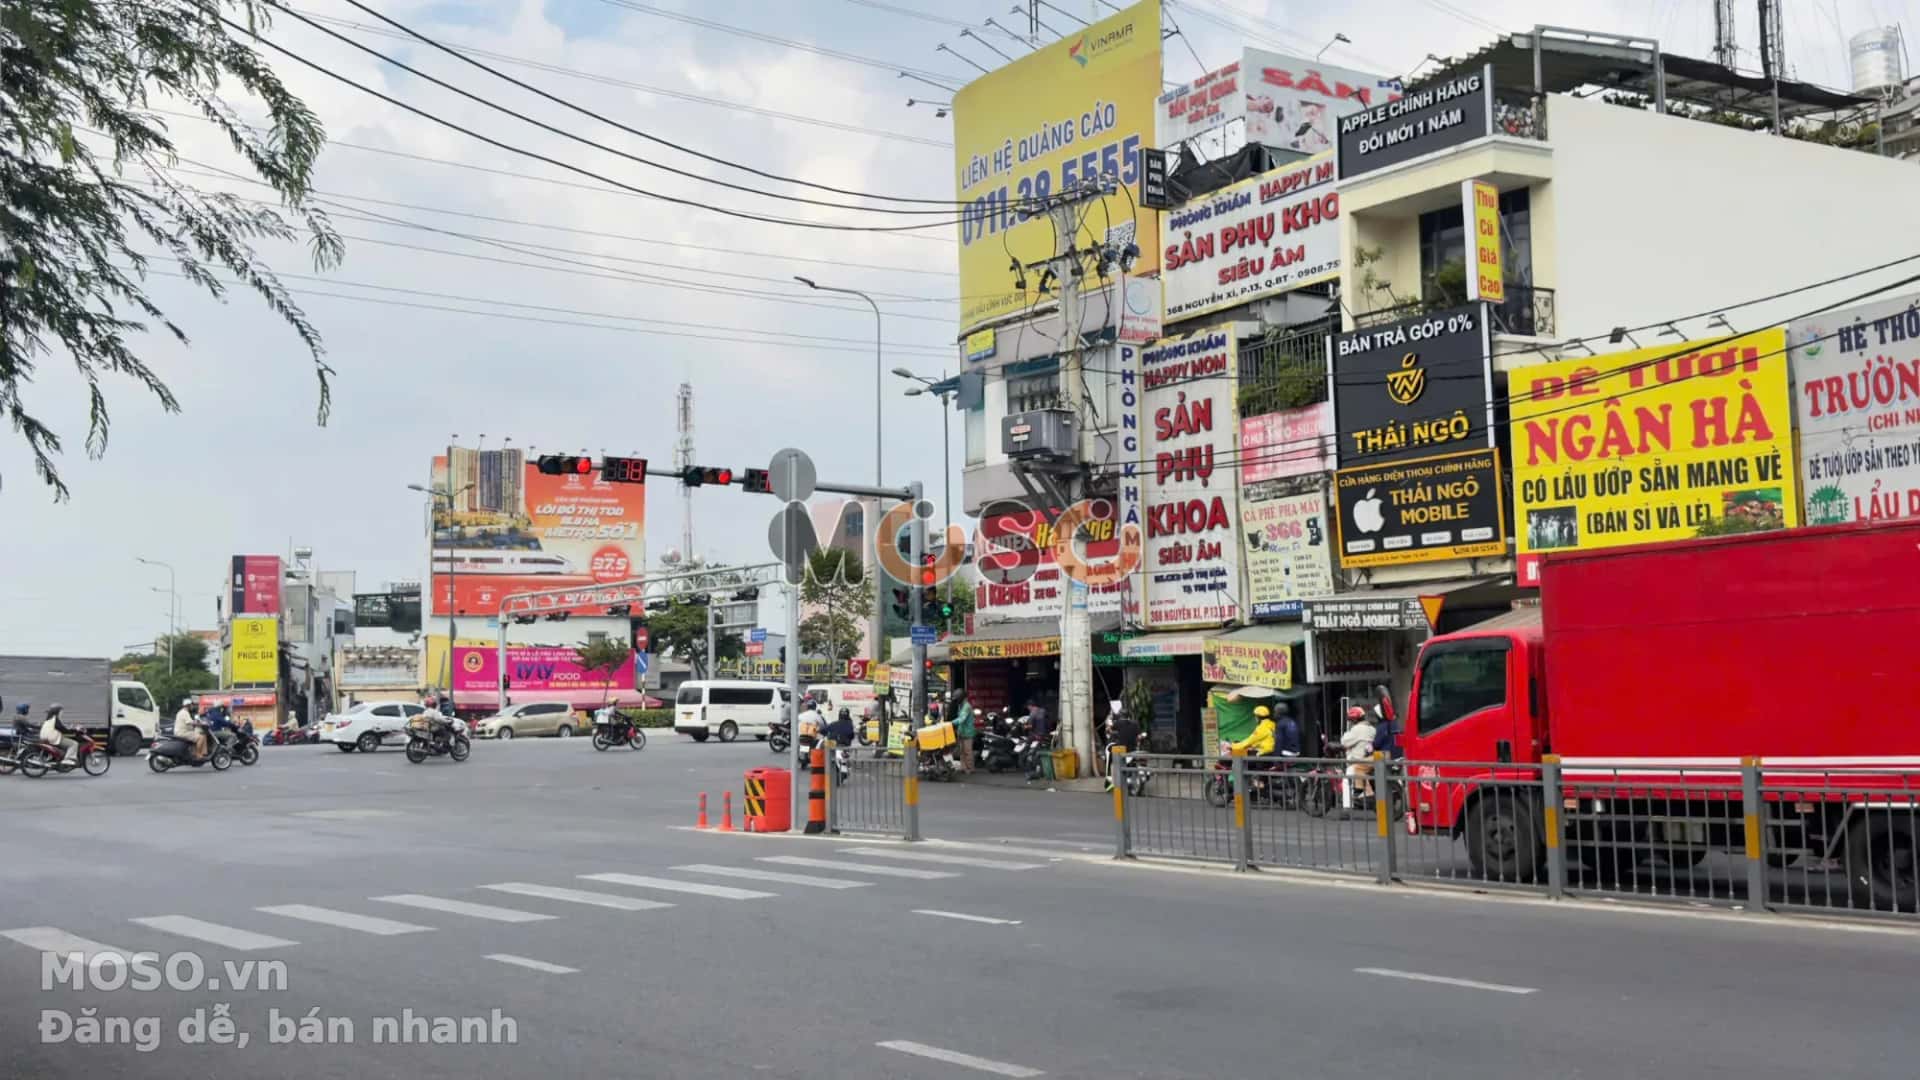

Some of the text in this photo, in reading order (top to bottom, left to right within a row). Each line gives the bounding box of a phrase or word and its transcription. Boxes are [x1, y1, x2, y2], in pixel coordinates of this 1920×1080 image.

[1341, 75, 1481, 134] APPLE CHÍNH HÃNG
[961, 101, 1116, 190] LIÊN HỆ QUẢNG CÁO
[1387, 123, 1415, 146] MỚI
[1417, 122, 1424, 135] 1
[1429, 109, 1463, 132] NĂM
[1170, 204, 1211, 231] PHÒNG
[1214, 192, 1252, 220] KHÁM
[1259, 167, 1313, 201] HAPPY
[1476, 189, 1495, 208] Thu
[1165, 229, 1215, 271] SẢN
[1220, 212, 1275, 254] PHỤ
[1218, 245, 1306, 285] SIÊU ÂM
[1479, 275, 1501, 294] Cao
[1142, 333, 1227, 366] PHÒNG KHÁM
[1339, 313, 1473, 356] BÁN TRẢ GÓP 0%
[1838, 316, 1868, 357] HỆ
[1143, 352, 1227, 388] HAPPY MOM
[1531, 346, 1759, 402] DÊ TƯƠI
[1154, 390, 1213, 442] SẢN
[1352, 419, 1407, 454] THÁI
[1413, 409, 1469, 444] NGÔ
[1524, 378, 1774, 467] NGÂN HÀ
[1868, 414, 1899, 432] (CHI
[1156, 443, 1214, 488] PHỤ
[1339, 476, 1357, 488] CỬA
[1357, 472, 1382, 485] HÀNG
[1384, 469, 1405, 483] ĐIỆN
[1464, 458, 1492, 471] HÃNG
[1885, 442, 1910, 468] THEO
[1389, 475, 1480, 506] THÁI NGÔ
[1522, 474, 1547, 504] CÓ
[1553, 466, 1587, 501] LẨU
[1640, 458, 1680, 493] SẴN
[1687, 456, 1750, 488] MANG
[1756, 445, 1784, 482] VỀ
[1147, 496, 1230, 539] KHOA
[1243, 498, 1321, 523] CÀ PHÊ PHA MÁY
[1401, 501, 1470, 526] MOBILE
[1656, 502, 1681, 529] VÀ
[1854, 479, 1900, 521] LẨU
[544, 527, 596, 538] METRO
[1158, 538, 1222, 566] SIÊU ÂM
[1313, 611, 1401, 628] THÁI NGÔ MOBILE
[988, 645, 1001, 657] XE
[1004, 642, 1043, 656] HONDA
[553, 673, 581, 681] FOOD
